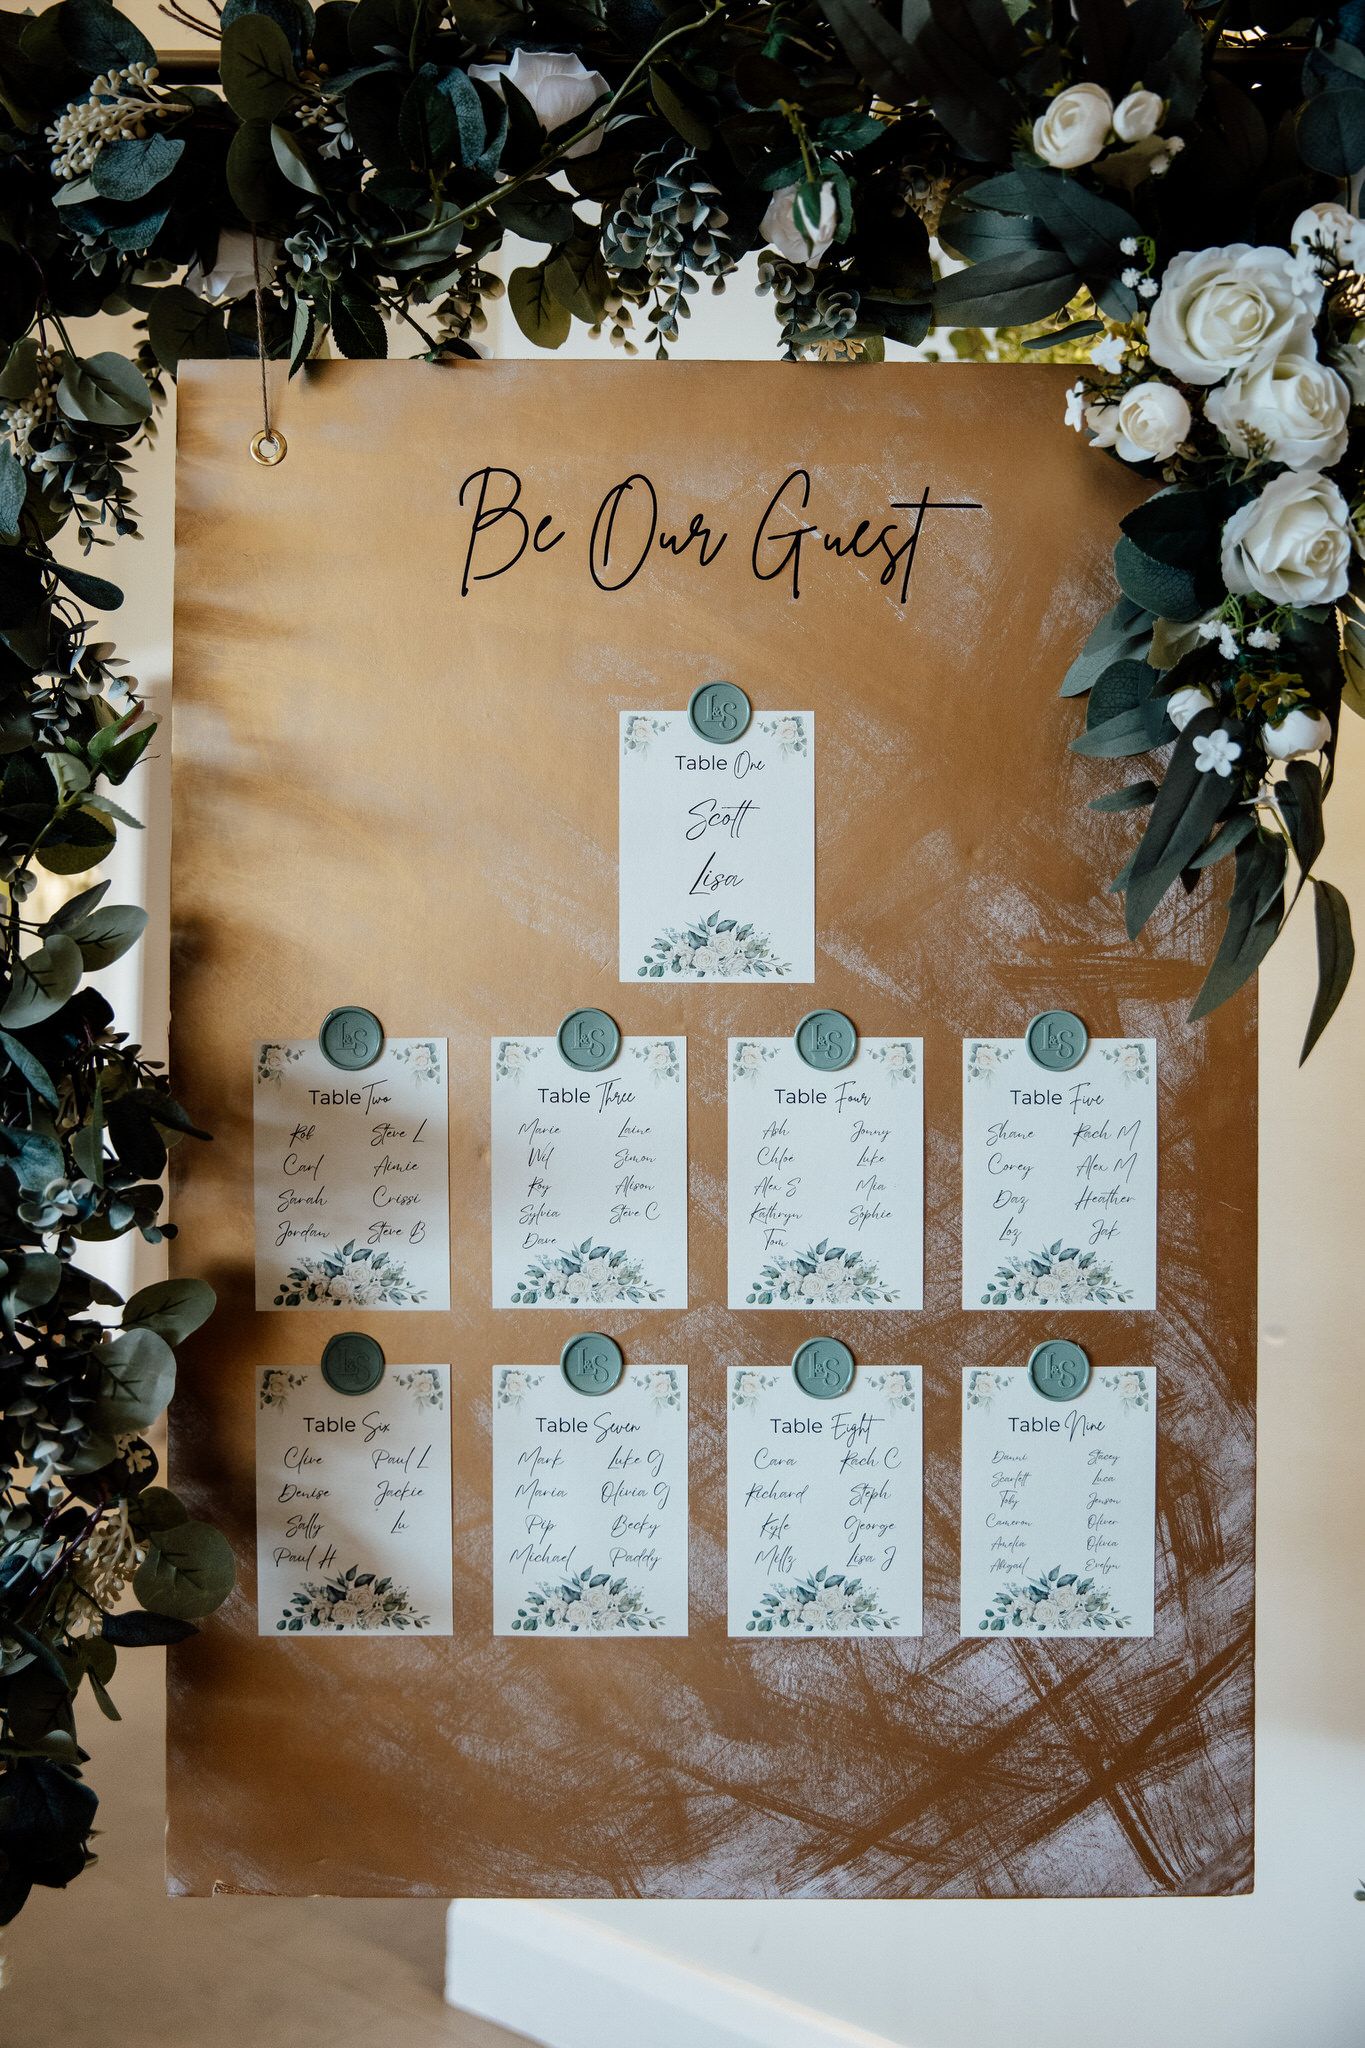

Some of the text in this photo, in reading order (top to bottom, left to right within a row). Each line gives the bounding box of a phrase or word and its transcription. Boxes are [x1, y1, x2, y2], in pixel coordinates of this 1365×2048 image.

[459, 466, 982, 604] Be Our Guest
[675, 750, 765, 779] Table One
[685, 798, 760, 840] Scott
[689, 851, 744, 895] Lisa
[308, 1079, 392, 1115] Table Two
[538, 1078, 636, 1113] Table Three
[774, 1081, 871, 1113] Table Four
[1010, 1082, 1104, 1114] Table Five
[290, 1124, 316, 1147] Rob
[371, 1118, 427, 1146] Steve L
[518, 1118, 561, 1145] Marie
[763, 1119, 789, 1139] Ash
[986, 1120, 1035, 1146] Shane
[1072, 1120, 1141, 1151] Rach M
[283, 1153, 325, 1181] Carl
[614, 1149, 656, 1168] Simon
[857, 1146, 886, 1167] Luke
[988, 1153, 1034, 1180] Corey
[1077, 1153, 1138, 1183] Alex M
[277, 1186, 327, 1212] Sarah
[528, 1177, 552, 1197] Roy
[615, 1175, 655, 1197] Alison
[754, 1176, 801, 1198] Alex S
[856, 1175, 887, 1201] Mia
[1075, 1185, 1136, 1210] Heather
[519, 1203, 560, 1225] Sylvia
[609, 1201, 661, 1224] Steve C
[749, 1202, 802, 1226] Kathryn
[993, 1189, 1029, 1214] Daz
[849, 1202, 892, 1231] Sophie
[275, 1220, 330, 1247] Jordan
[367, 1220, 426, 1244] Steve B
[522, 1233, 556, 1249] Dave
[763, 1228, 788, 1250] Tom
[999, 1217, 1022, 1246] Loz
[1089, 1219, 1121, 1244] Jak
[303, 1411, 390, 1442] Table Six
[536, 1412, 640, 1443] Table Seven
[770, 1412, 885, 1448] Table Eight
[1008, 1410, 1106, 1442] Table Nine
[284, 1446, 324, 1474] Clive
[371, 1445, 432, 1473] Paul L
[518, 1446, 565, 1477] Mark
[608, 1446, 642, 1469] Luke
[754, 1447, 798, 1469] Cara
[840, 1447, 901, 1474] Rach C
[1088, 1449, 1120, 1466] Stacey
[991, 1470, 1032, 1487] Scarlett
[1092, 1469, 1115, 1485] Luca
[278, 1483, 330, 1503] Denise
[374, 1480, 424, 1506] Jackie
[515, 1479, 567, 1509] Maria
[601, 1480, 648, 1506] Olivia
[745, 1480, 809, 1507] Richard
[849, 1479, 891, 1513] Steph
[1000, 1490, 1020, 1510] Toby
[286, 1513, 325, 1539] Sally
[391, 1510, 410, 1534] Lu
[525, 1514, 556, 1544] Pip
[611, 1513, 660, 1538] Becky
[760, 1513, 791, 1539] Kyle
[844, 1515, 895, 1543] George
[985, 1513, 1033, 1528] Cameron
[1087, 1513, 1119, 1530] Oliver
[1086, 1535, 1119, 1553] Olivia
[273, 1544, 337, 1571] Paul H
[509, 1544, 576, 1574] Michael
[609, 1547, 662, 1571] Paddy
[755, 1545, 797, 1576] Millz
[846, 1544, 897, 1572] Lisa J
